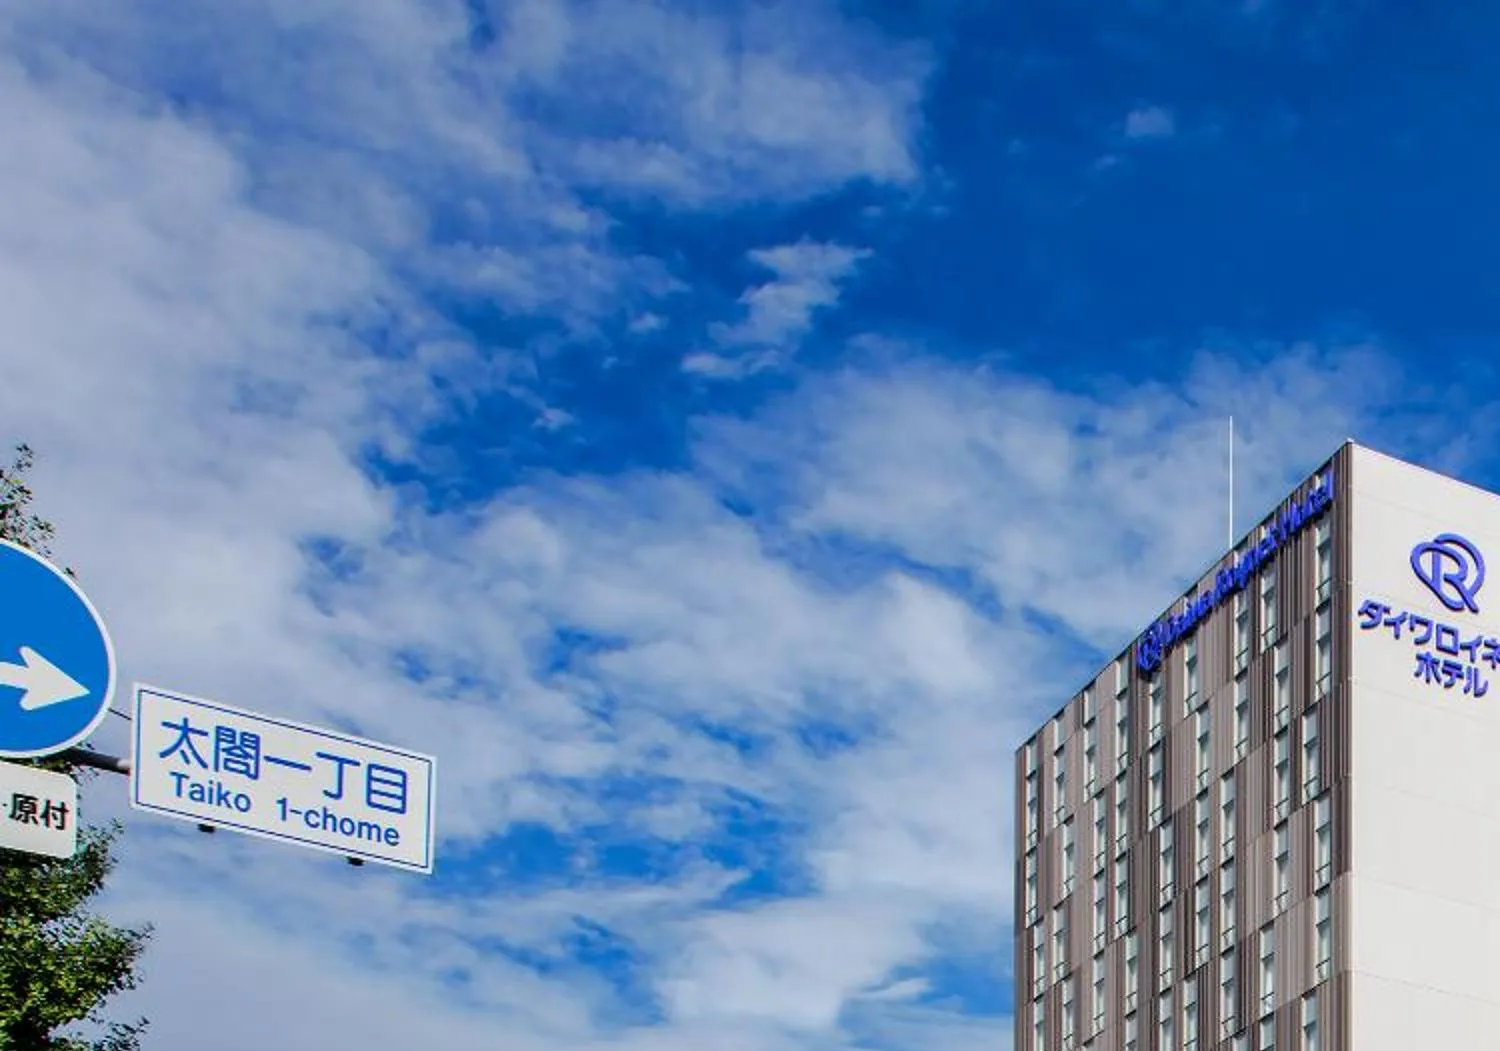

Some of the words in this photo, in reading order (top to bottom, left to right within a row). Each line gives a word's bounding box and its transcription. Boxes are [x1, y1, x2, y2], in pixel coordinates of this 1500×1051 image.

[1414, 651, 1488, 698] ホテル
[159, 717, 408, 814] 太閤一丁目
[168, 771, 251, 813] Taiko
[276, 797, 400, 847] 1-chome
